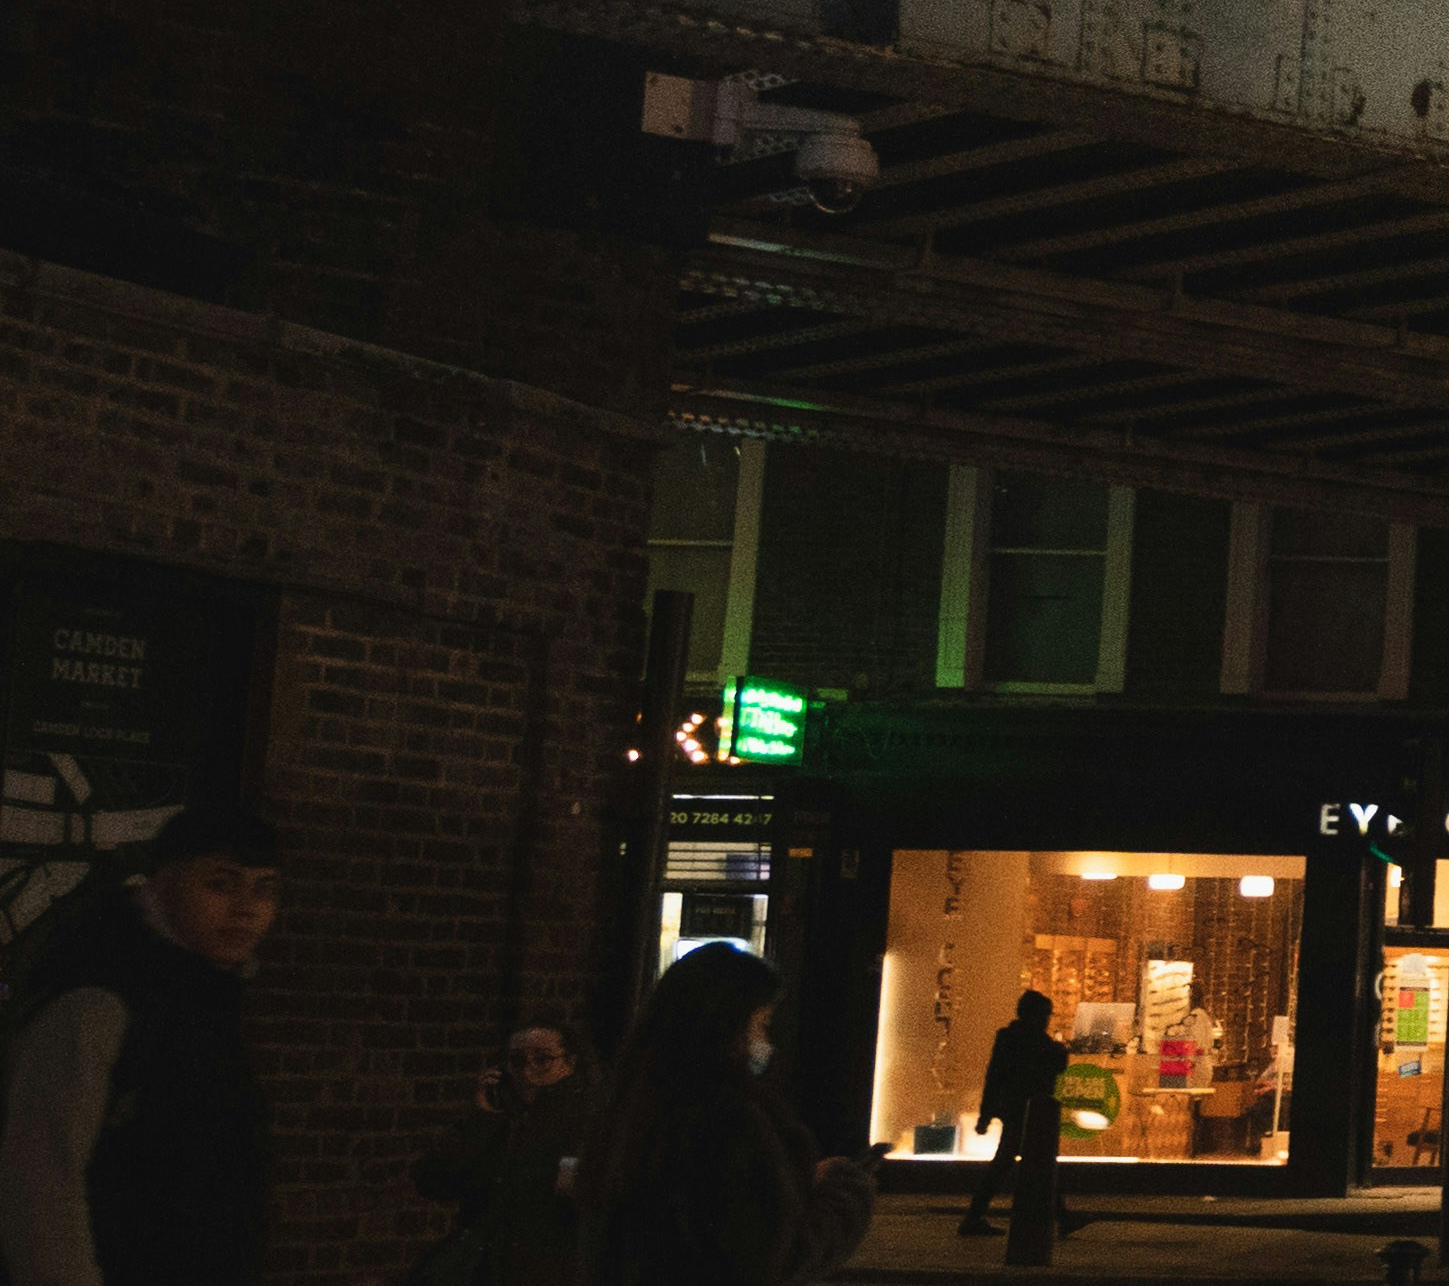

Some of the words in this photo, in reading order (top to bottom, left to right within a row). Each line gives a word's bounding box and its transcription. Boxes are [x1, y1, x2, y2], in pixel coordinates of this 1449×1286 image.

[53, 628, 147, 661] CAMDEN
[51, 658, 143, 691] MARKET
[733, 814, 772, 825] 427
